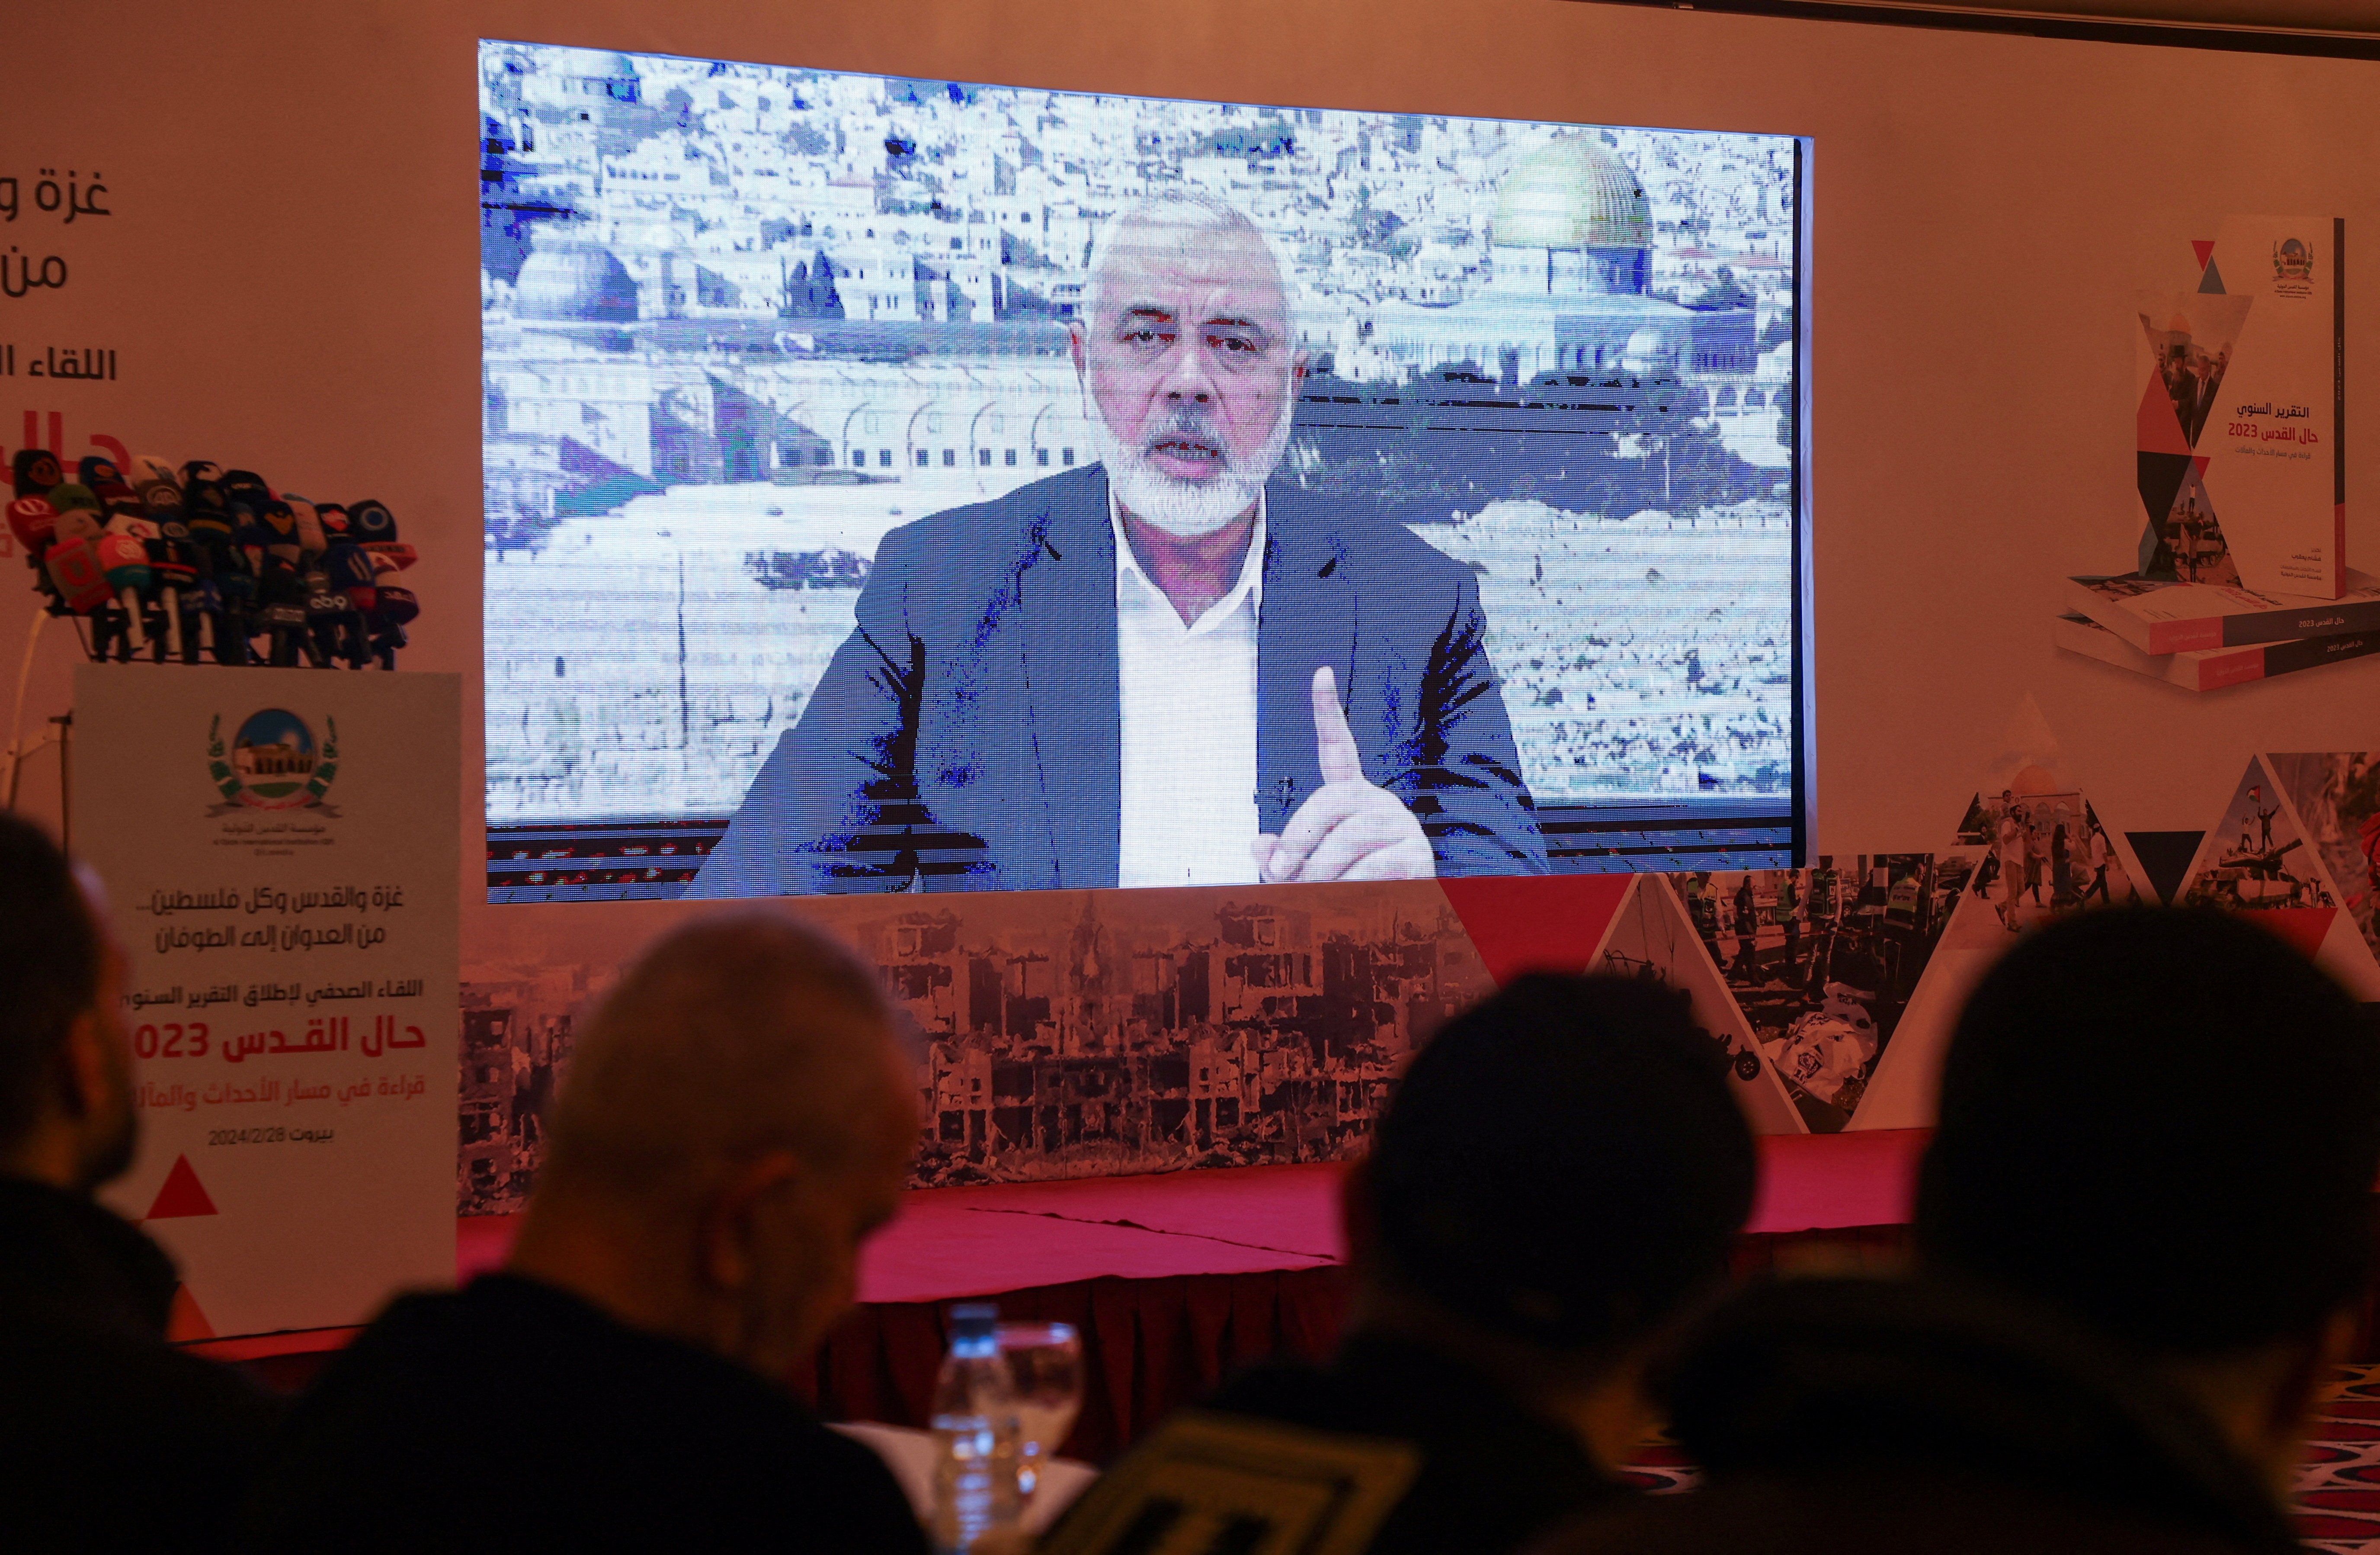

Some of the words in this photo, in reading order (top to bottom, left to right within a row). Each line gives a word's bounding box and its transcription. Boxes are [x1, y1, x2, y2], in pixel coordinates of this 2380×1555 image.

[34, 167, 112, 224] غزة
[1, 246, 67, 298] من
[28, 346, 117, 381] اللقاء
[2237, 402, 2271, 418] السنوي
[2274, 405, 2310, 419] التقرير
[2228, 422, 2258, 438] 2023
[2261, 426, 2296, 442] القدس
[2299, 428, 2318, 445] حال
[2299, 619, 2314, 628] 2023
[2316, 618, 2333, 628] القدس
[2334, 617, 2344, 627] حال
[2327, 644, 2340, 653] 2023
[2340, 641, 2354, 651] القدس
[245, 886, 288, 915] وكل
[292, 885, 366, 913] والقدس
[372, 885, 403, 911] غزة
[156, 925, 236, 954] الطوفان
[240, 925, 278, 952] إلى
[281, 923, 352, 951] العدوان
[358, 922, 387, 949] من
[187, 984, 238, 1009] التقرير
[243, 982, 301, 1007] لإطلاق
[306, 980, 373, 1004] الصحفي
[377, 979, 423, 998] اللقاء
[135, 1021, 210, 1059] 023
[221, 1016, 348, 1063] القدس
[360, 1014, 426, 1057] حال
[203, 1076, 280, 1104] الأحداث
[284, 1079, 331, 1106] مسار
[337, 1078, 372, 1107] في
[378, 1075, 425, 1101] قراءة
[208, 1127, 284, 1146] 2024/2/28
[289, 1127, 333, 1144] بيروت
